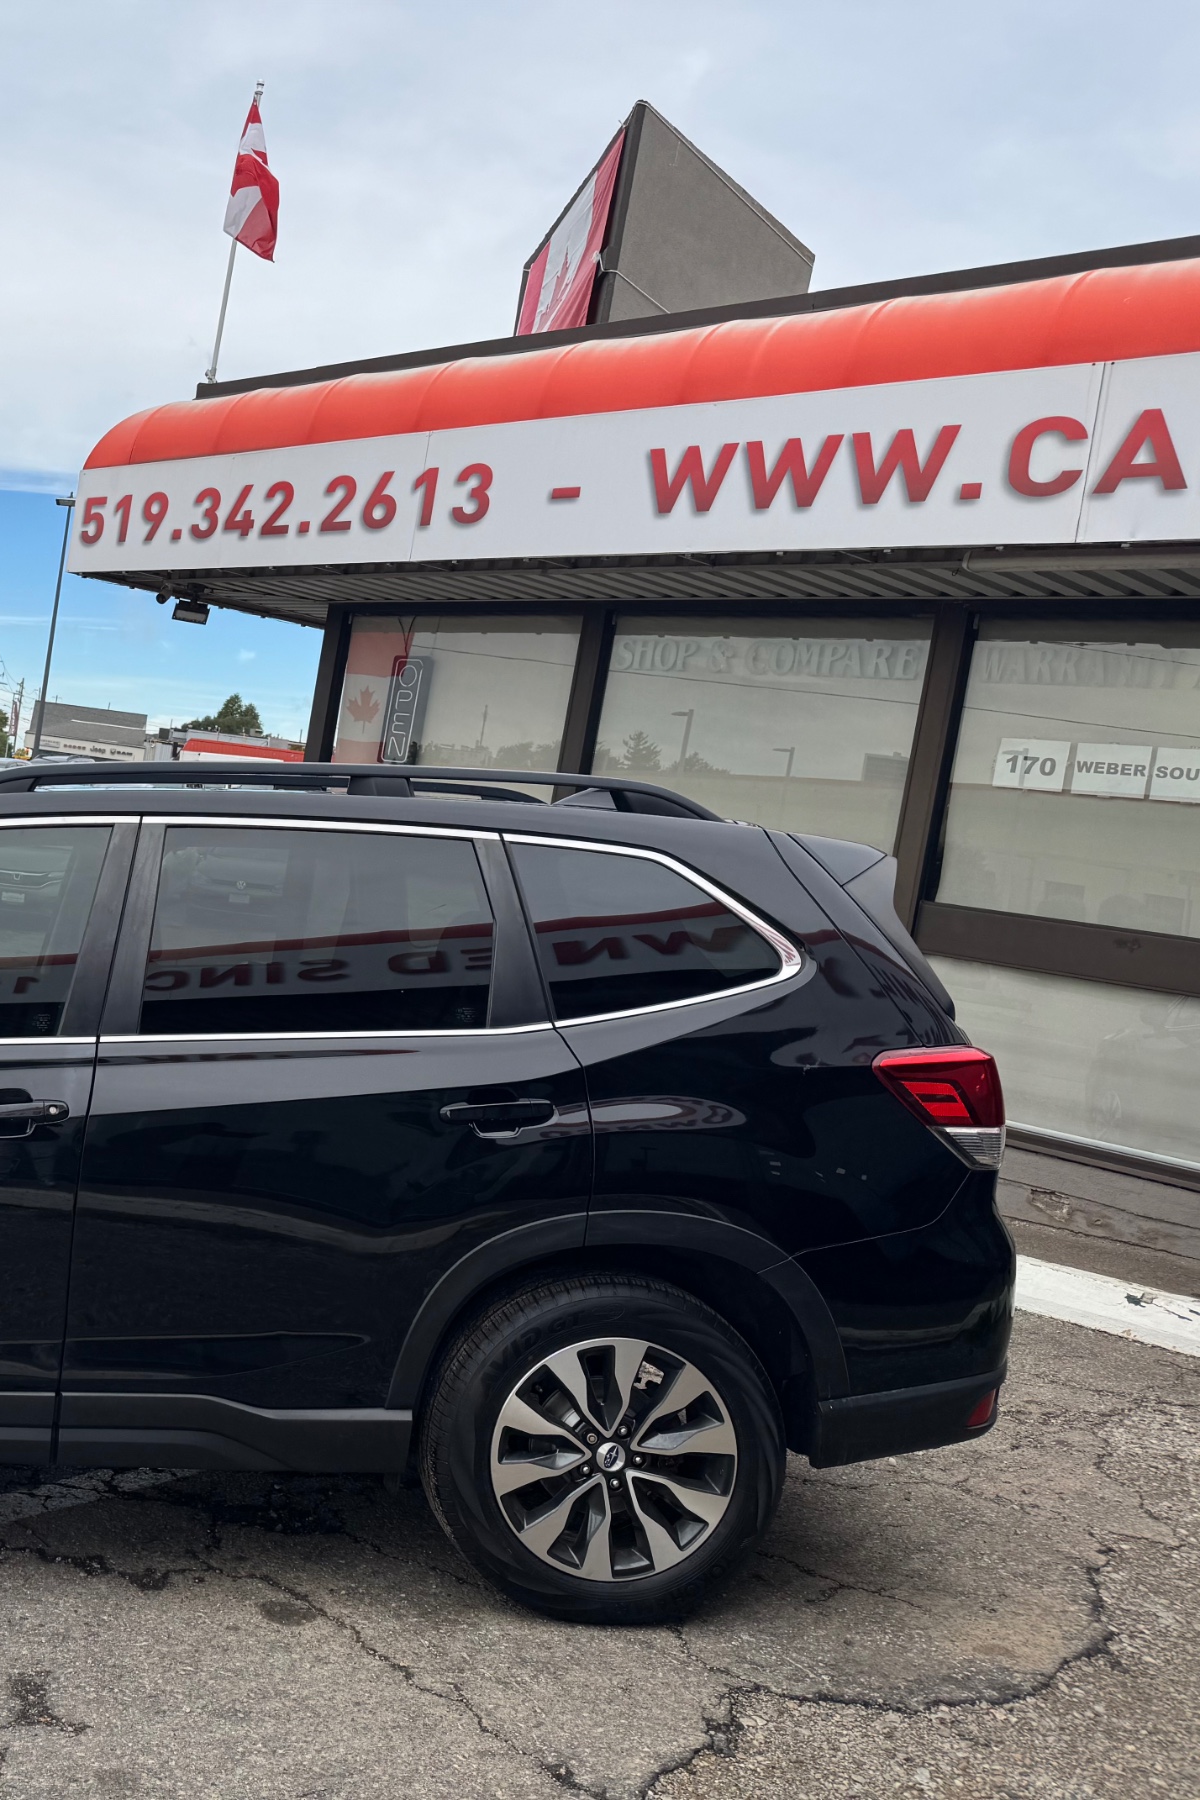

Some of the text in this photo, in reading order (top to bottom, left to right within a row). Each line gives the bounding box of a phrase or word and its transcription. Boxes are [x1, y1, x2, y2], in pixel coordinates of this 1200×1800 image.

[80, 463, 494, 545] 519.342.2613
[650, 408, 1188, 514] WWW.CA
[616, 637, 698, 672] SHOP
[747, 640, 923, 681] COMPARE
[387, 664, 418, 757] OPEN
[1006, 755, 1200, 780] 170 WEBER SOU
